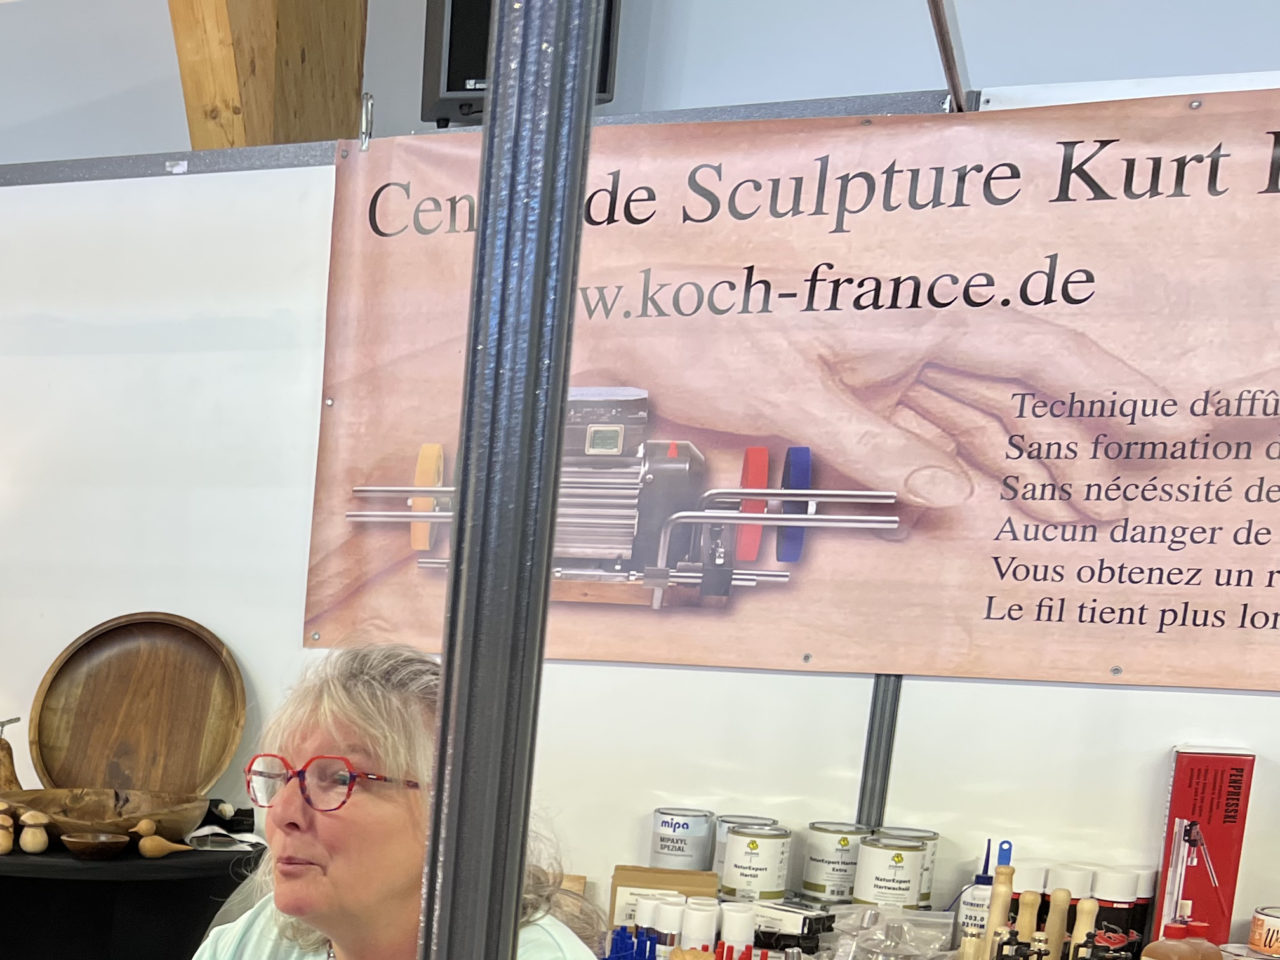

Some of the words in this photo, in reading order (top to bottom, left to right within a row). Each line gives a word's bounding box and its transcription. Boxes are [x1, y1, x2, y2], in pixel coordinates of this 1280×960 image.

[368, 180, 478, 238] Cen
[583, 168, 657, 226] de
[682, 153, 1022, 234] Sculpture
[1048, 138, 1232, 203] Kurt
[578, 252, 1096, 321] w.koch-france.de
[1011, 390, 1178, 425] Technique
[1005, 434, 1078, 460] Sans
[1088, 433, 1253, 460] formation
[1000, 475, 1073, 501] Sans
[1084, 475, 1233, 503] nécéssité
[1244, 476, 1280, 503] de
[993, 516, 1098, 543] Aucun
[1109, 517, 1223, 551] danger
[1232, 519, 1272, 546] de
[991, 556, 1065, 583] Vous
[1076, 558, 1203, 586] obtenez
[1214, 567, 1254, 587] un
[983, 595, 1024, 621] Le
[1033, 597, 1066, 623] fil
[1077, 598, 1148, 625] tient
[1155, 601, 1226, 634] plus
[660, 818, 689, 833] mipa
